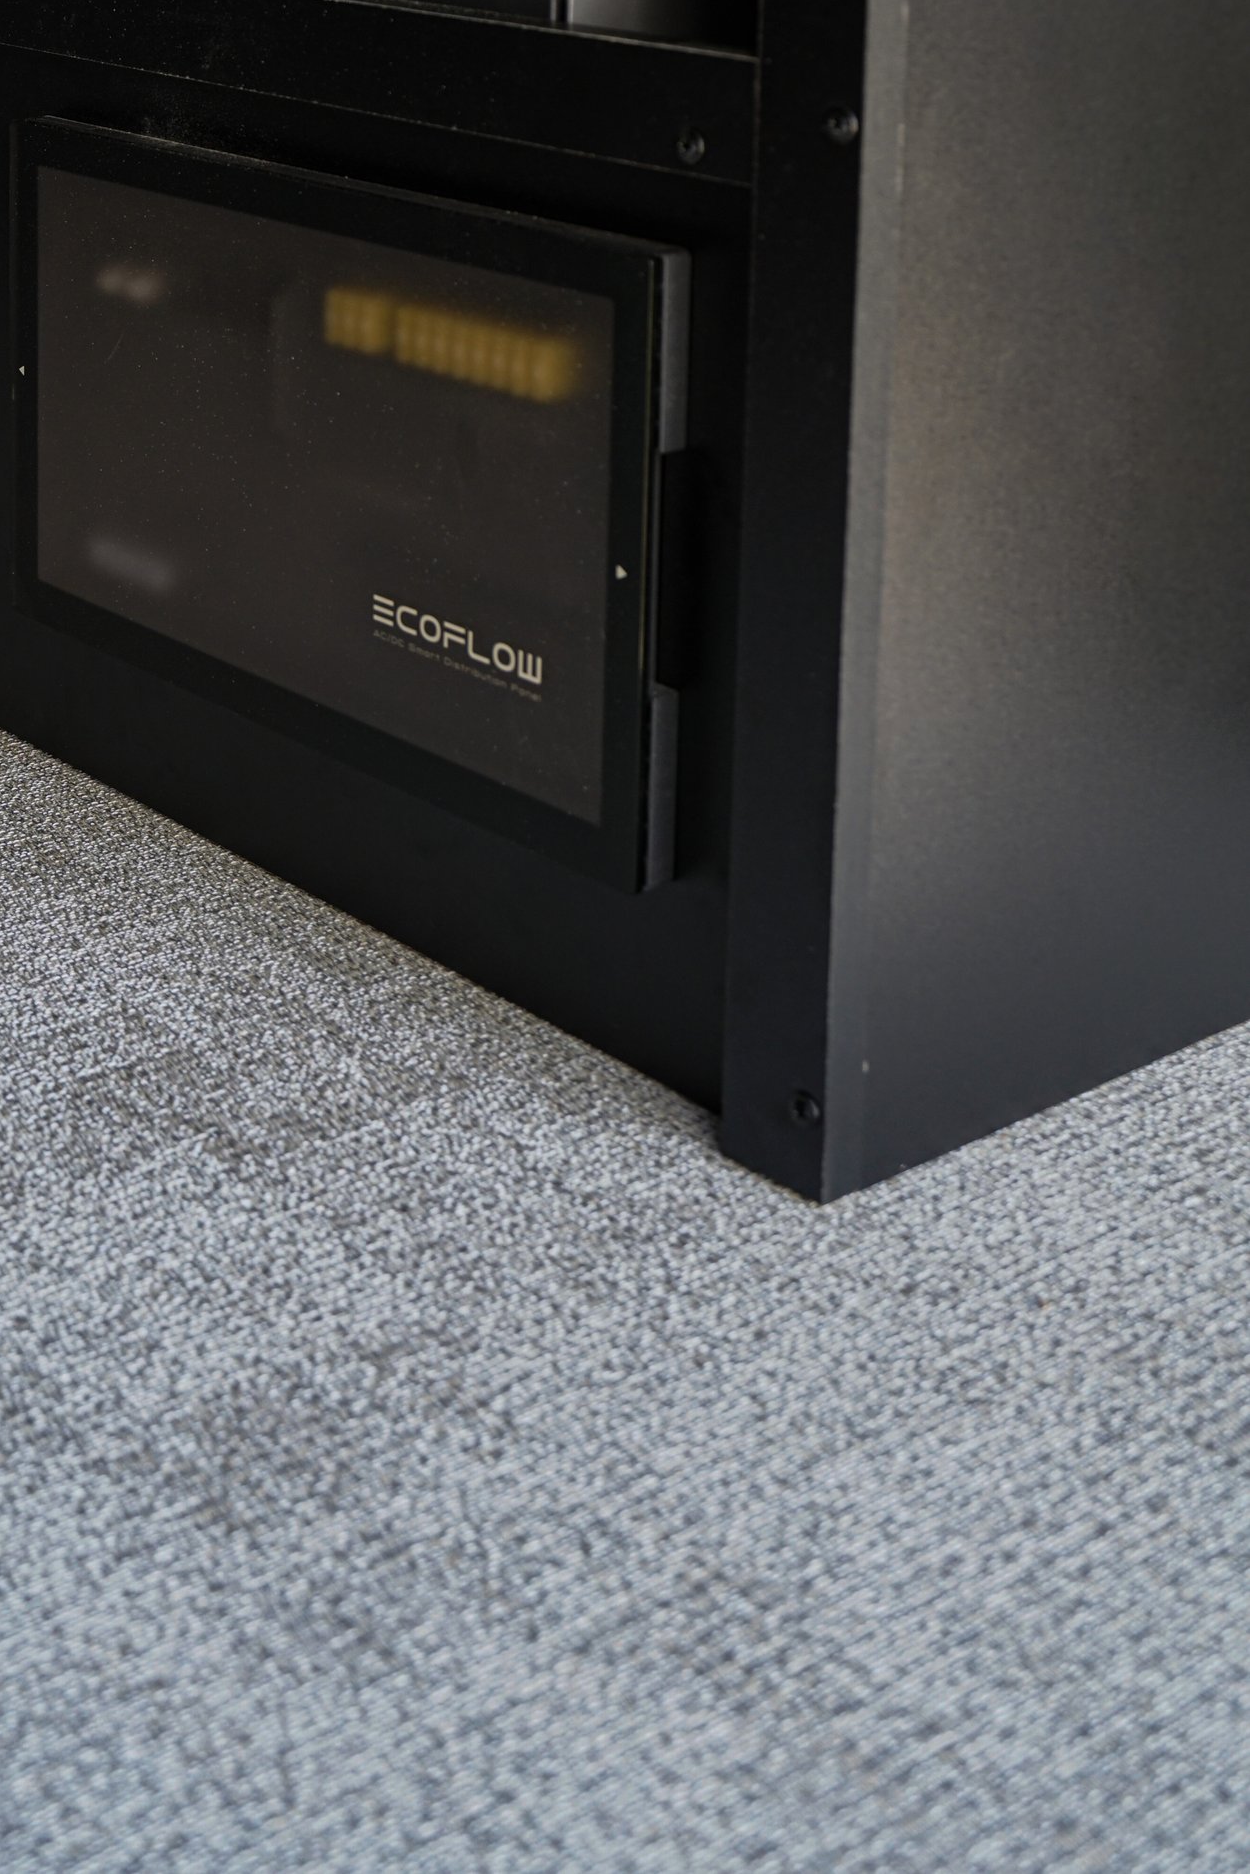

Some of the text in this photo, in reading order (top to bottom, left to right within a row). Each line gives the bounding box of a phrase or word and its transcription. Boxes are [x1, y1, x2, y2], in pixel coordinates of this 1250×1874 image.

[372, 593, 543, 685] ECOFLOW
[372, 629, 542, 703] AC/DC Smart Distribution Panel
